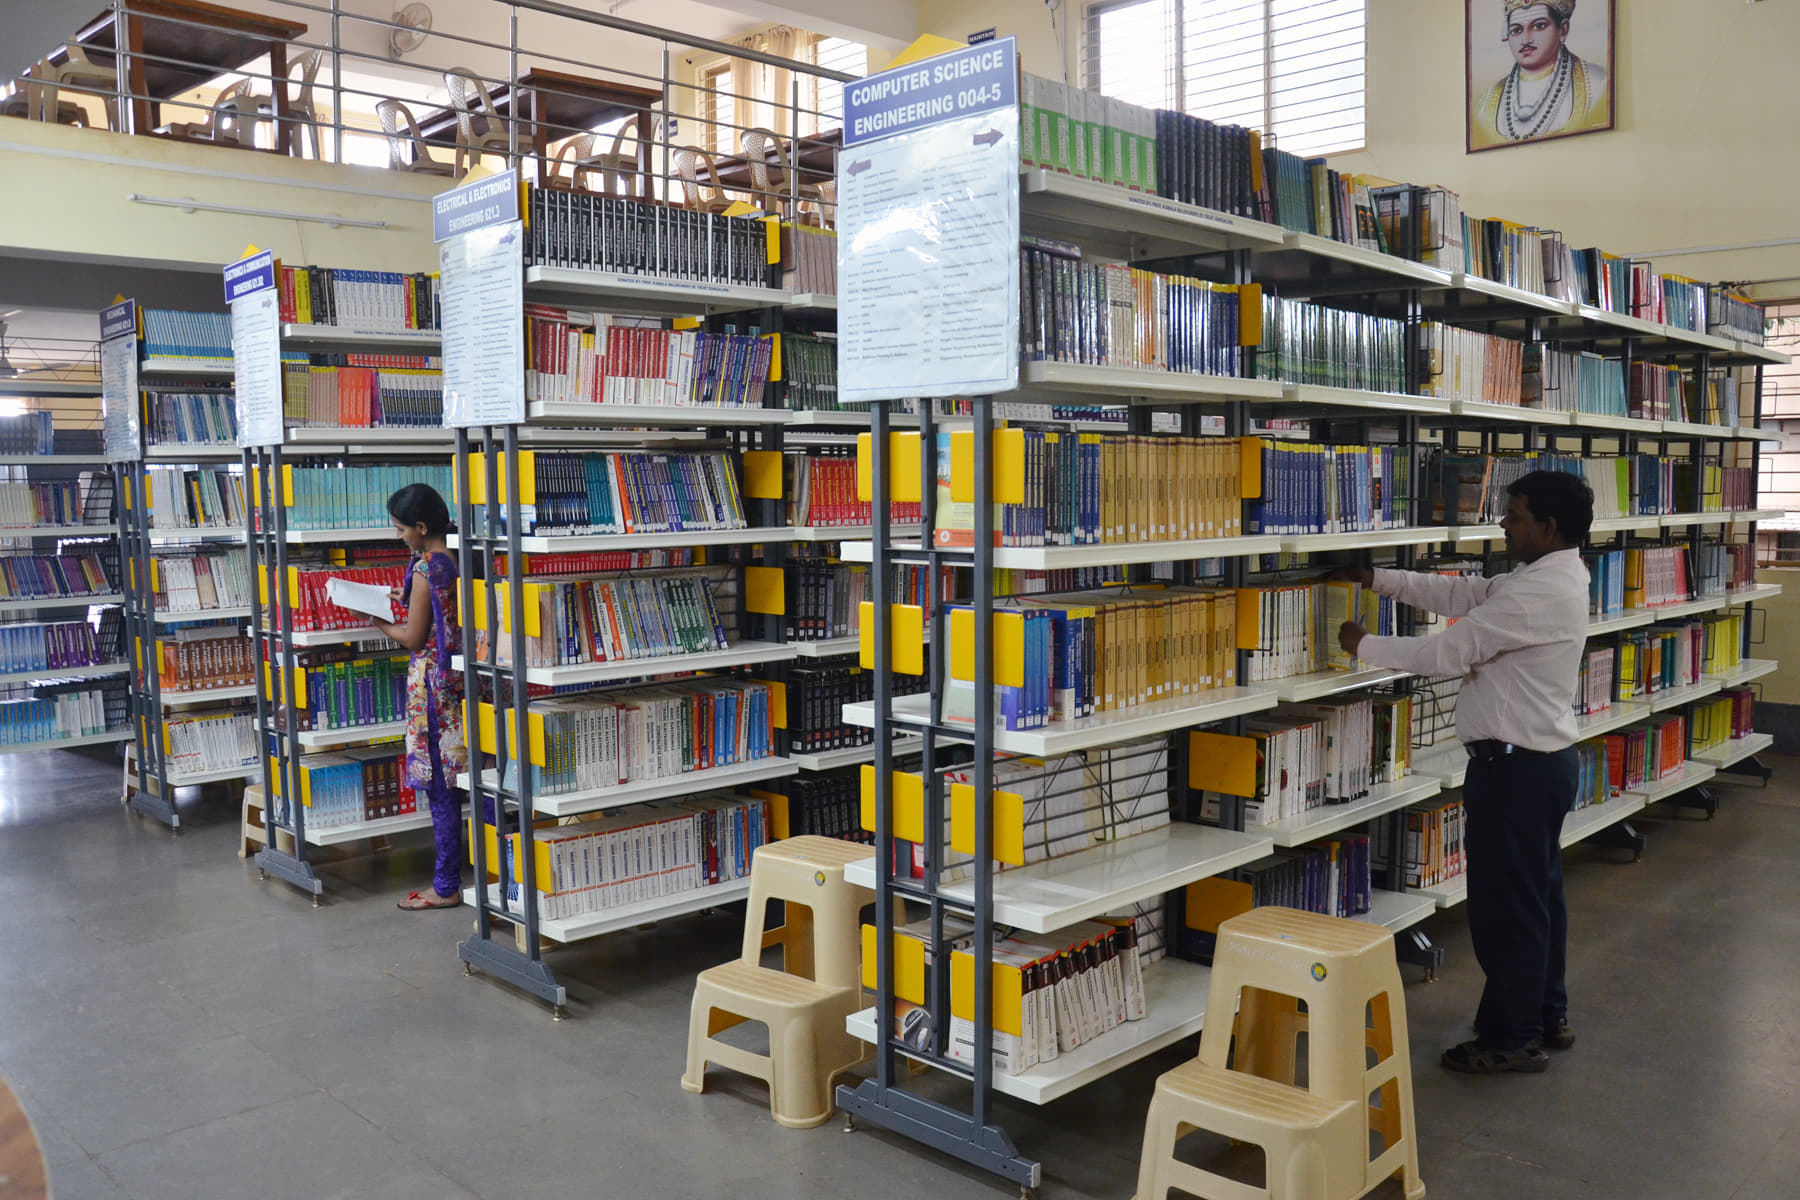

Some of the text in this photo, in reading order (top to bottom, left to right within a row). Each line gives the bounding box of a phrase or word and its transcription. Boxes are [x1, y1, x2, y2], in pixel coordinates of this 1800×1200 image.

[852, 49, 1003, 107] COMPUTER SCIENCE
[854, 83, 1002, 136] ENGINEERING 004-5
[437, 193, 467, 215] ELECTRICAL
[474, 177, 511, 202] ELECTRONICS
[449, 209, 484, 232] ENGINEERING
